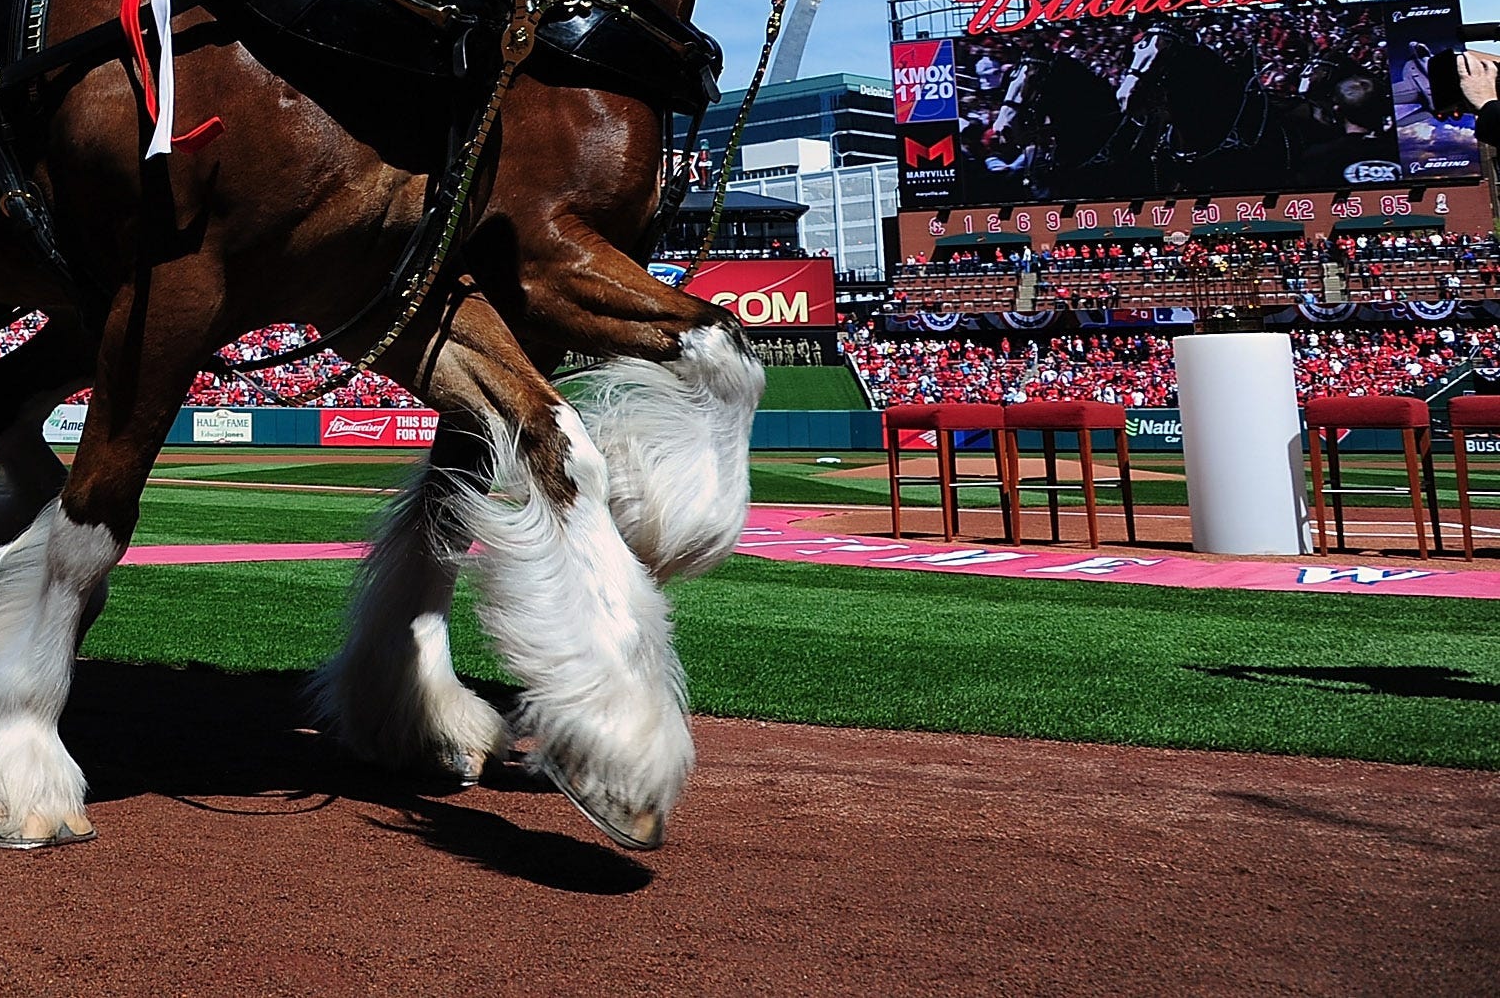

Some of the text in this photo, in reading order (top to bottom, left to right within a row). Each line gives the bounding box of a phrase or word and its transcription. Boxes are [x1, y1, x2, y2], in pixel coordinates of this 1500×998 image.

[1406, 8, 1451, 17] BOEING
[894, 64, 953, 85] KMOX
[896, 82, 954, 102] 1120
[1424, 160, 1470, 168] BOEING
[906, 169, 955, 178] MARYVILLE
[1358, 165, 1396, 176] FOX
[964, 214, 973, 235] 1
[987, 213, 1001, 234] 2
[1016, 212, 1031, 232] 6
[1046, 212, 1061, 231] 9
[1076, 209, 1098, 229] 10
[1113, 208, 1136, 228] 14
[1152, 206, 1174, 226] 17
[1192, 203, 1221, 225] 20
[1236, 202, 1266, 221] 24
[1284, 199, 1315, 220] 42
[1331, 197, 1363, 219] 45
[1380, 195, 1412, 216] 85
[196, 418, 219, 427] HALL
[226, 418, 250, 428] FAME
[330, 420, 382, 433] Budweiser
[396, 416, 419, 428] THIS
[396, 429, 417, 441] FOR
